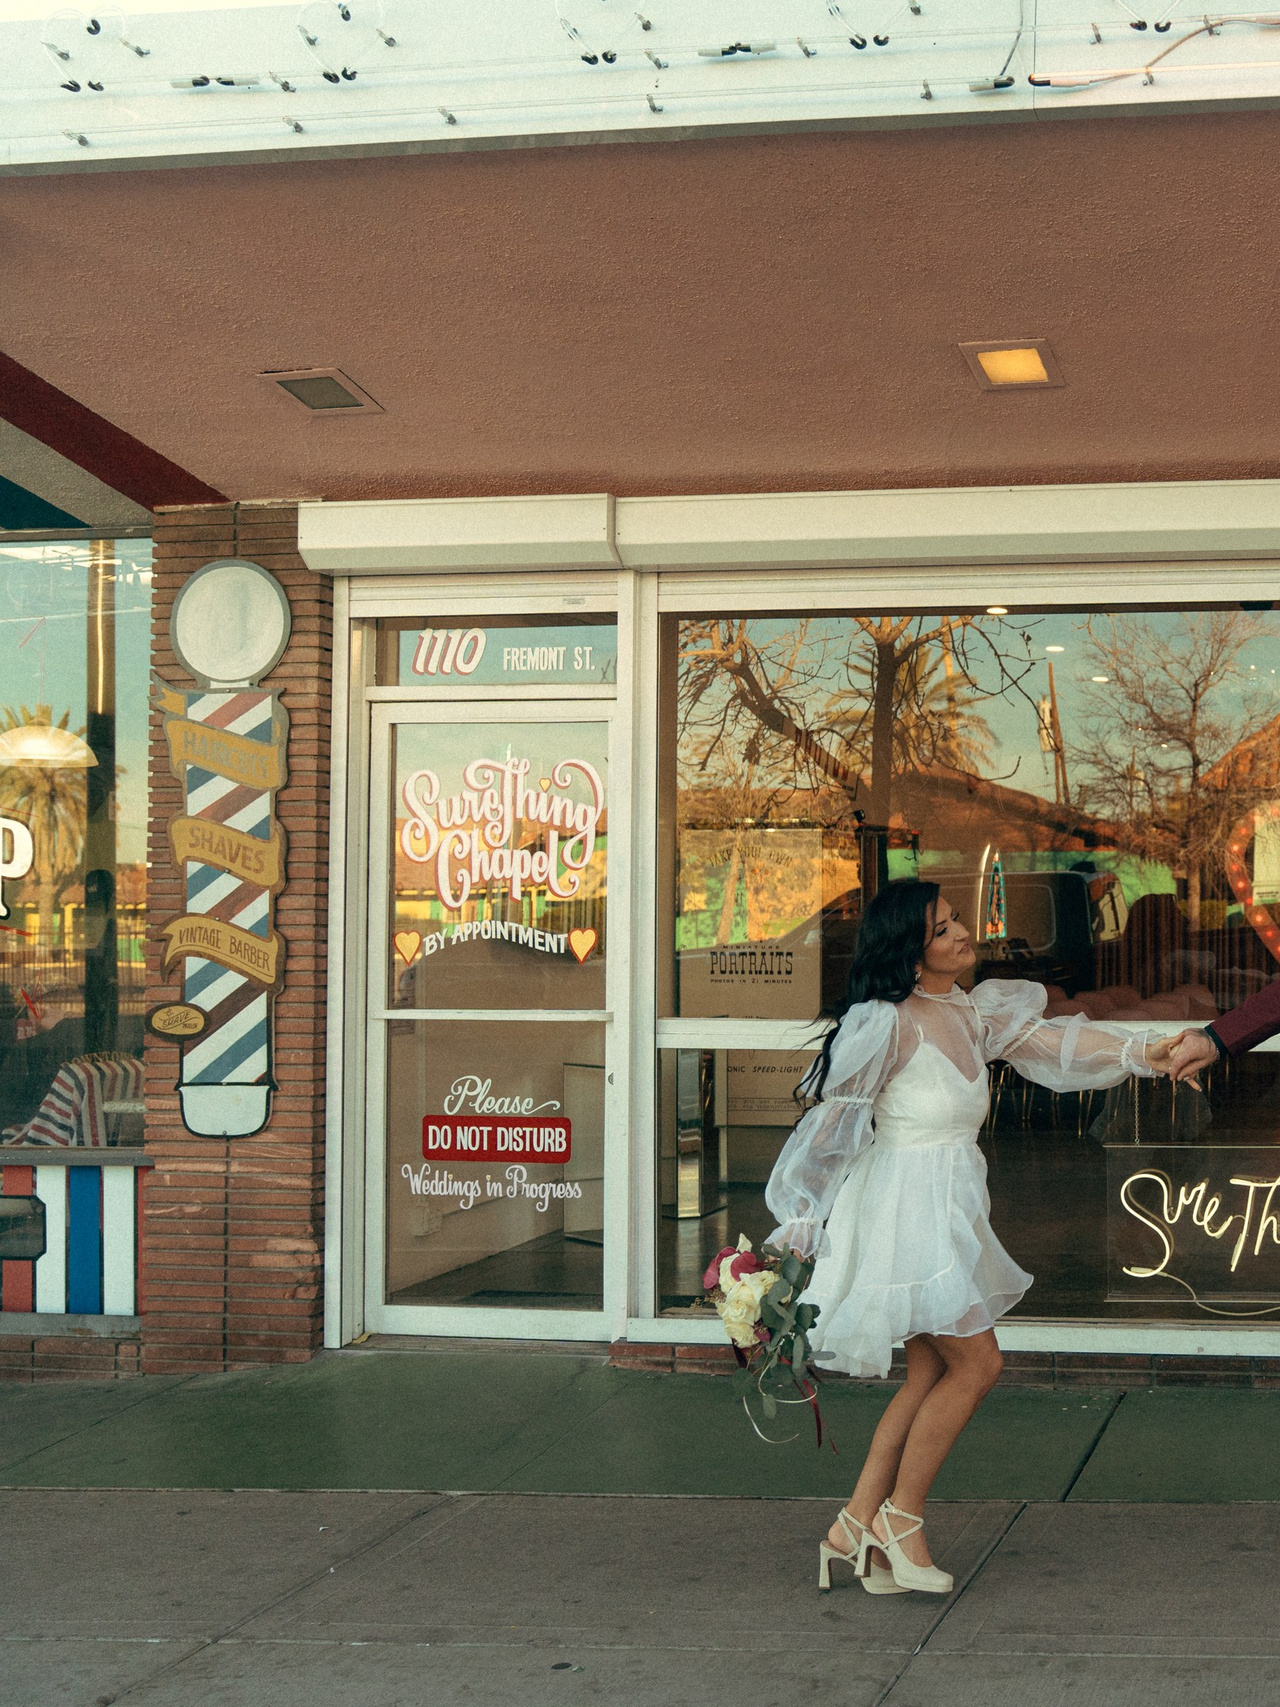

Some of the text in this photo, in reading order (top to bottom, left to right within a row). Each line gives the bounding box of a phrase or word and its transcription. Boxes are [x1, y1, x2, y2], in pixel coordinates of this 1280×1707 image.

[411, 627, 596, 677] 1110 FREMONT ST.
[183, 730, 268, 780] HAIRCUTS
[188, 825, 265, 875] SHAVES
[435, 827, 580, 911] Chapel
[178, 925, 270, 972] VINTAGE BARBER
[422, 919, 569, 956] BY APPOINTMENT
[710, 951, 794, 975] PORTRAITS
[162, 1010, 191, 1029] SHAVE
[752, 1065, 804, 1074] SPEED-LIGHT
[444, 1075, 561, 1116] Please
[428, 1125, 567, 1152] DO NOT DISTURB
[401, 1163, 582, 1212] Weddings in Progress
